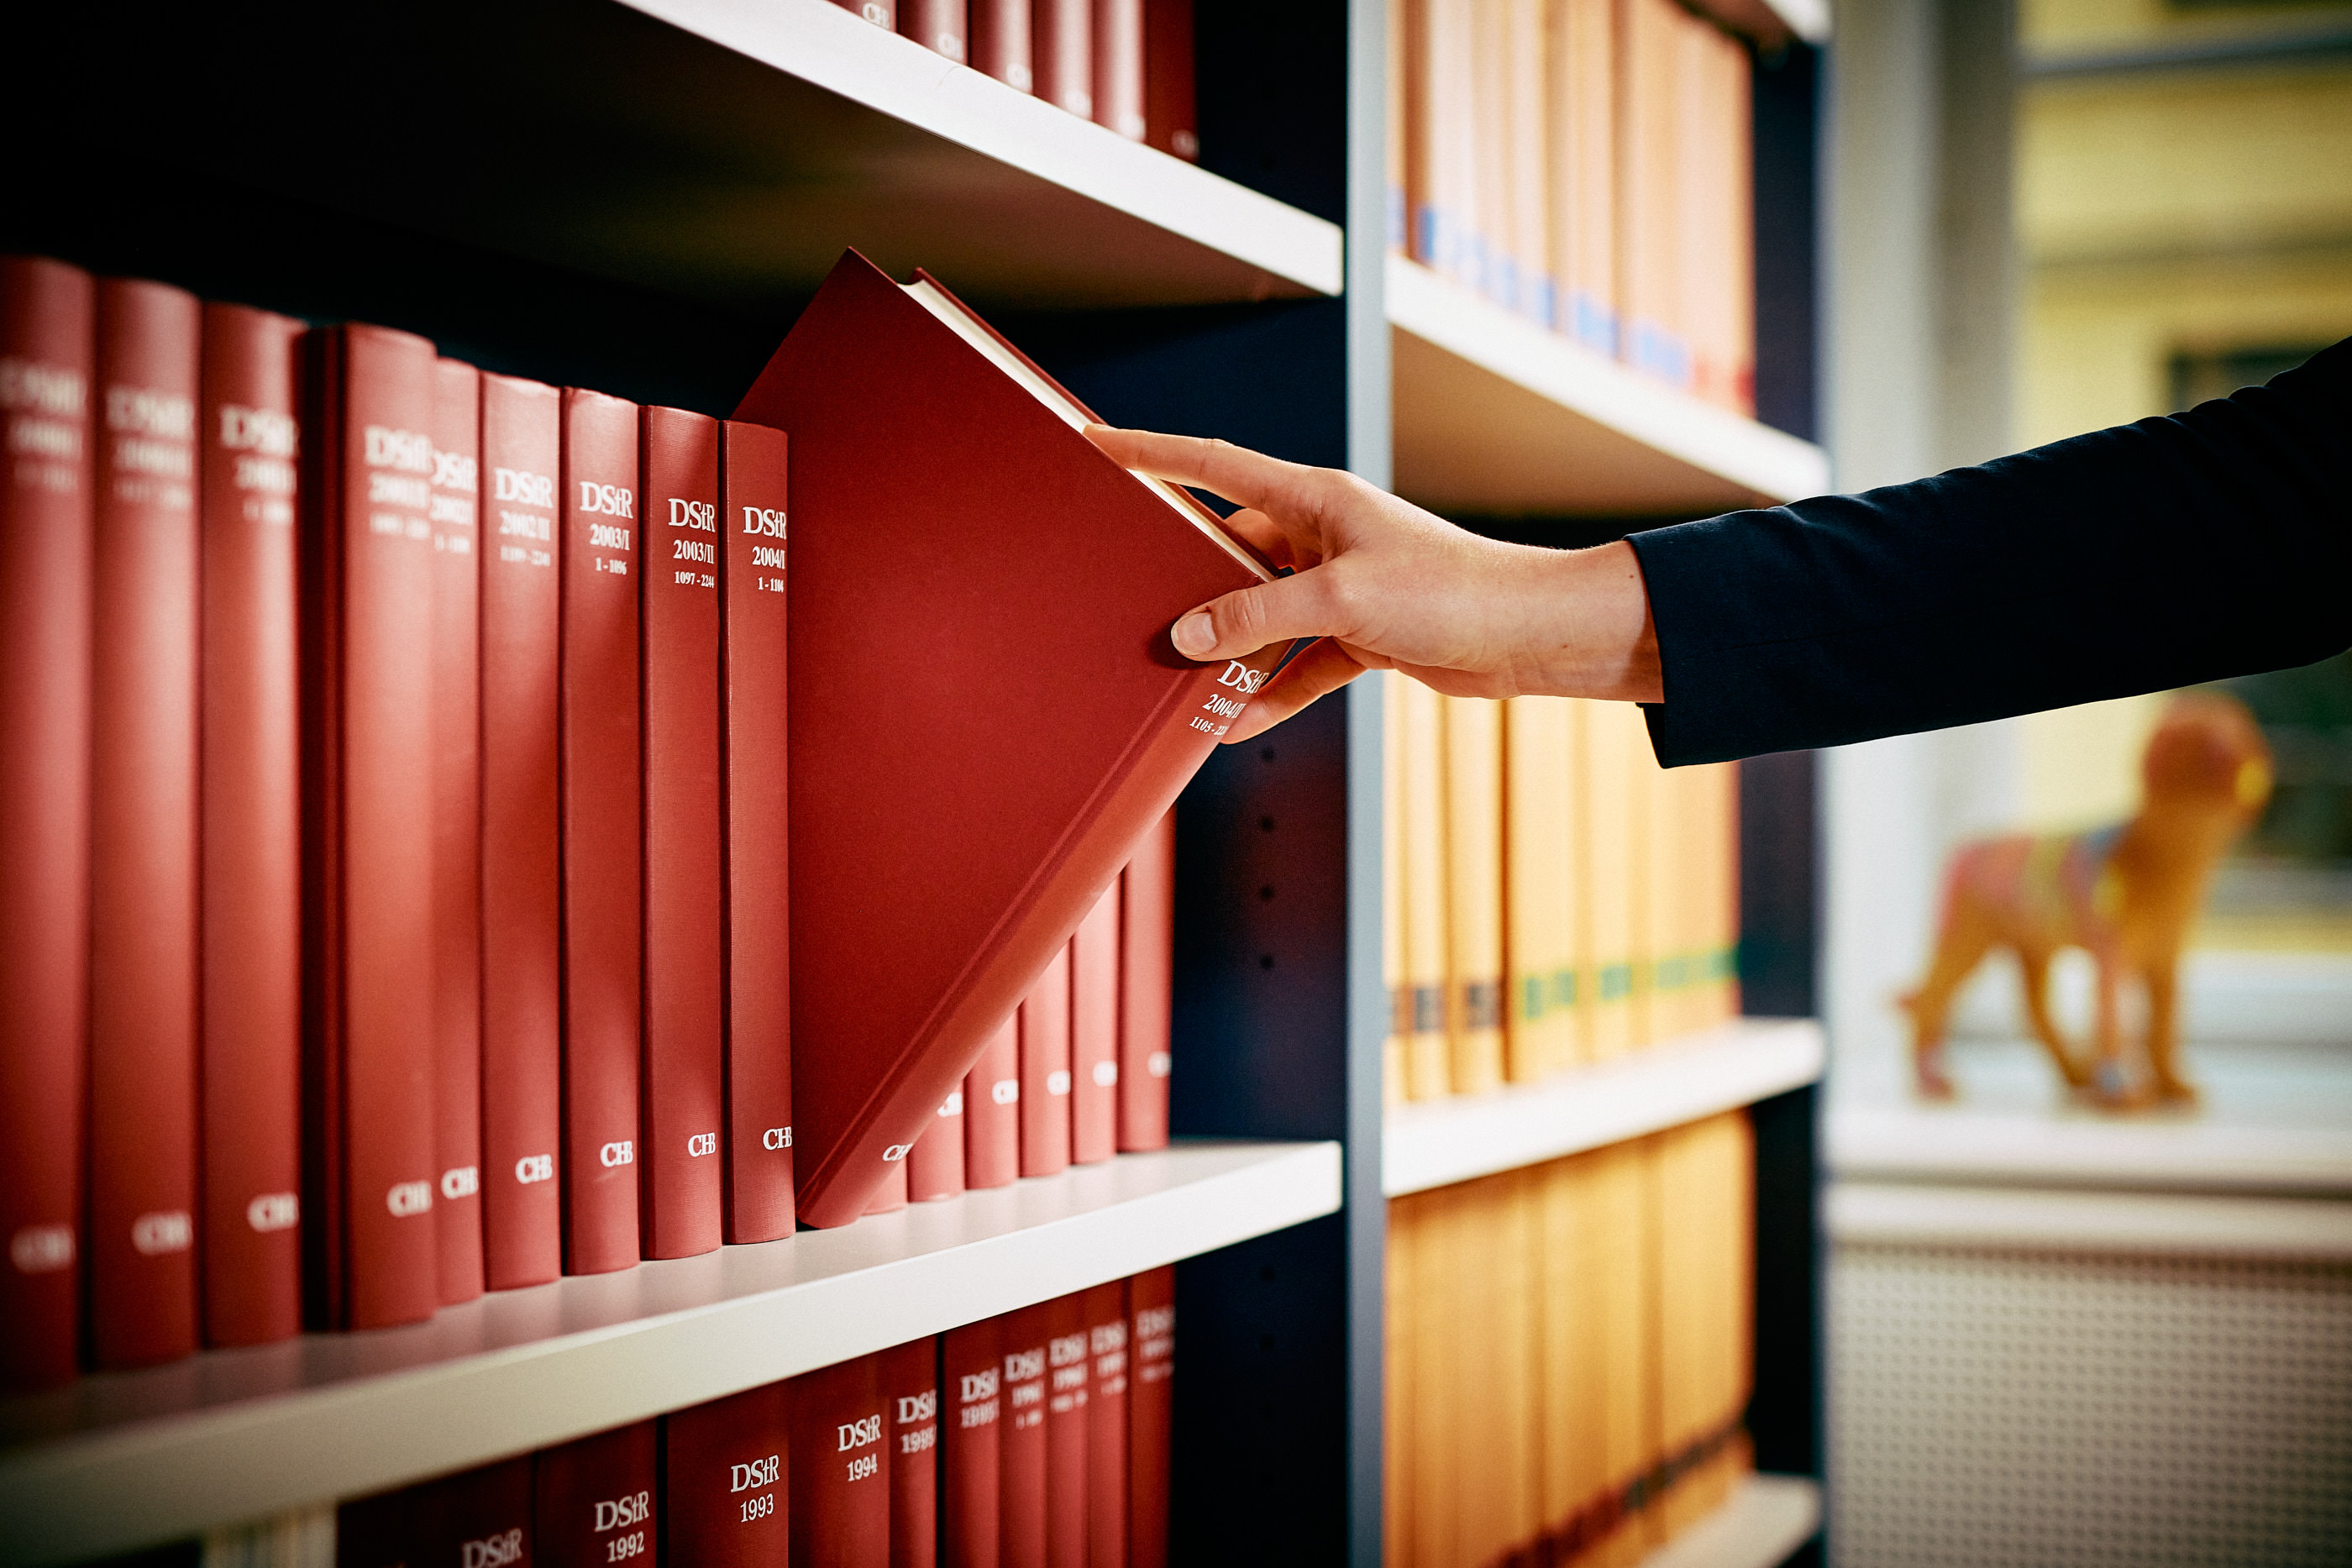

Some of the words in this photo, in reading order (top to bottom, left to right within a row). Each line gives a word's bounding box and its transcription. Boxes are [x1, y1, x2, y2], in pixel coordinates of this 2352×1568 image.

[494, 467, 554, 509] DStR
[580, 480, 633, 519] DStR
[668, 498, 716, 533] DStR
[743, 506, 787, 540] DStR
[589, 523, 630, 551] 2003/I
[673, 539, 715, 564] 2003/II
[752, 546, 785, 570] 2004/I
[1216, 659, 1270, 694] DStR
[1202, 693, 1247, 719] 2004/II
[600, 1141, 633, 1167] CHB
[688, 1132, 716, 1157] CHB
[763, 1127, 792, 1151] CHB
[515, 1153, 553, 1184] CHB
[837, 1413, 882, 1452] DStR
[730, 1454, 780, 1493] DStR
[846, 1452, 879, 1482] 1994
[594, 1490, 650, 1533] DStR
[739, 1492, 774, 1523] 1993
[461, 1527, 523, 1568] DStR
[606, 1530, 645, 1563] 1992
